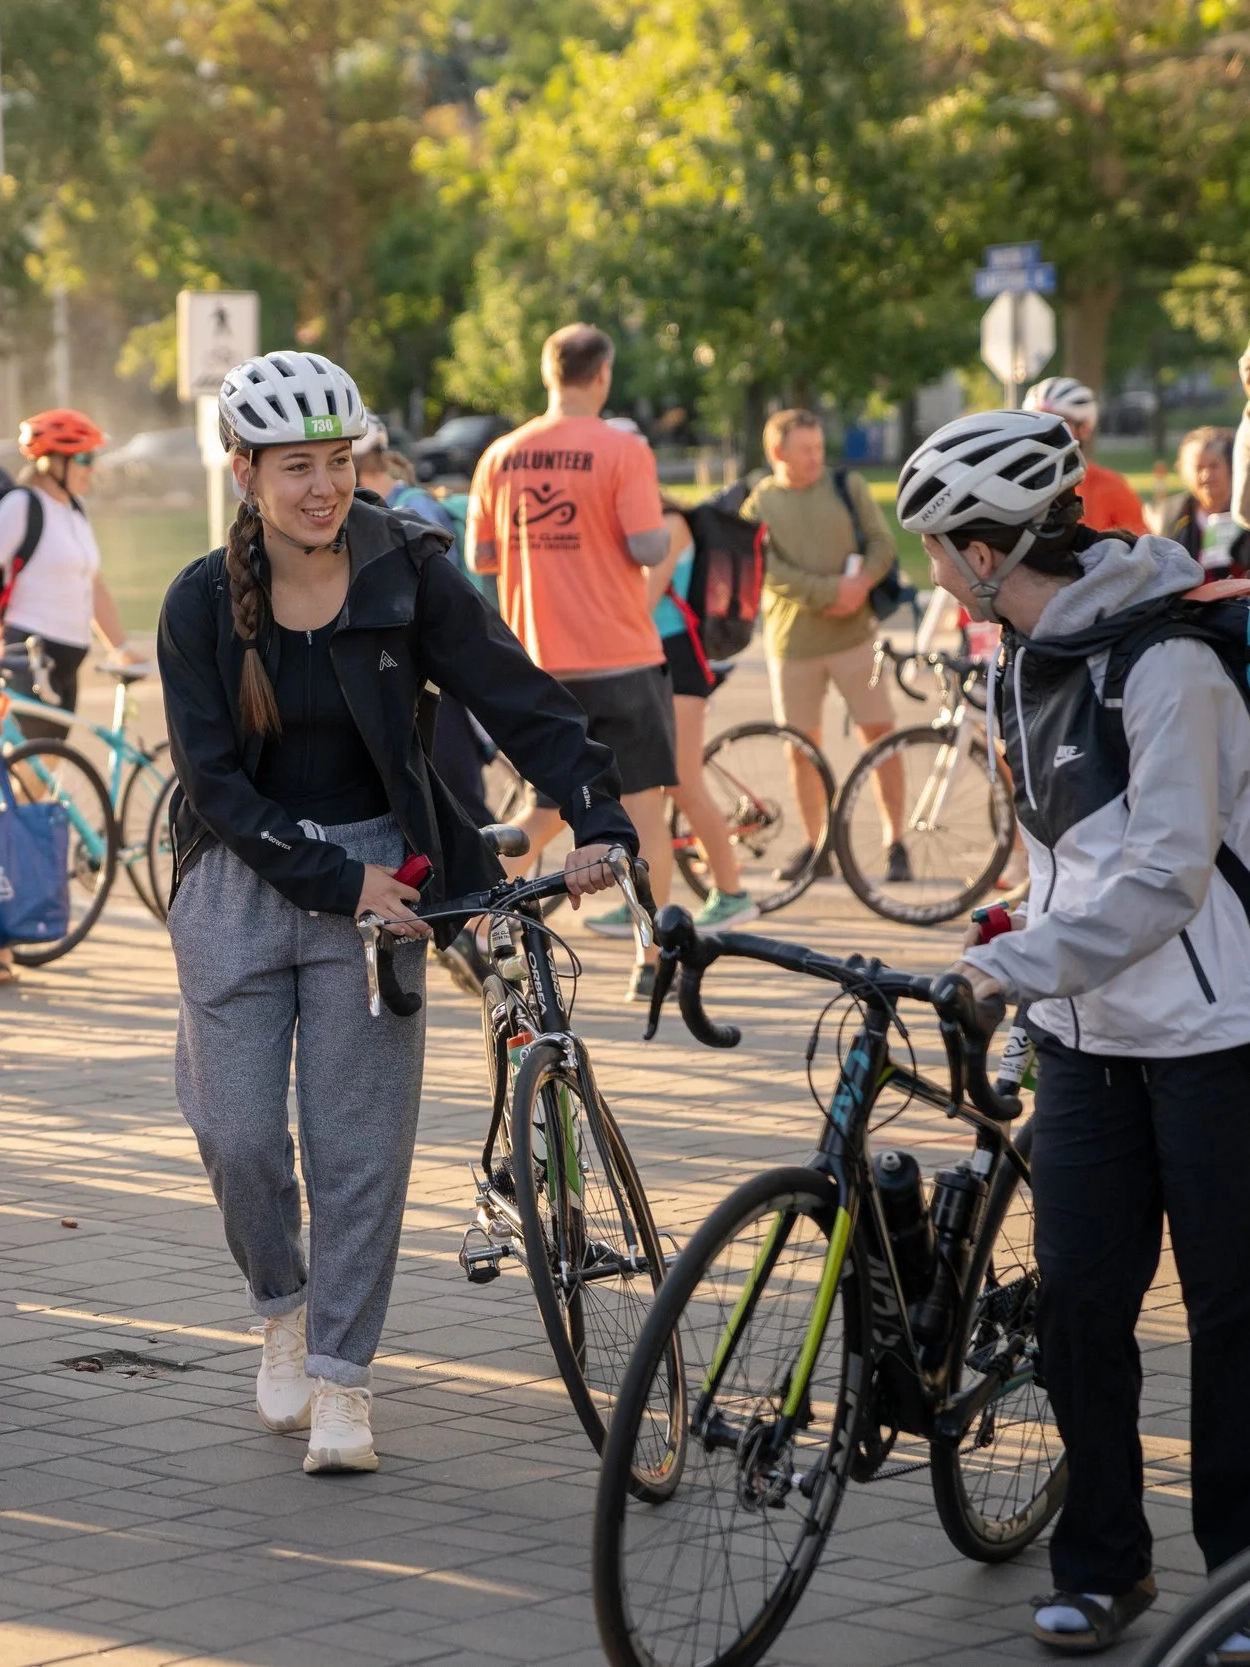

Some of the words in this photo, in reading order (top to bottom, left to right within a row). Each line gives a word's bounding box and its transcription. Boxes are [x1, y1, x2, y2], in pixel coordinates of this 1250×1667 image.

[311, 418, 333, 432] 730
[502, 450, 594, 472] VOLUNTEER
[922, 488, 951, 522] RUDY
[582, 786, 591, 809] 7MESH
[268, 836, 292, 850] GORE-TEX
[528, 952, 548, 1016] ORBEA
